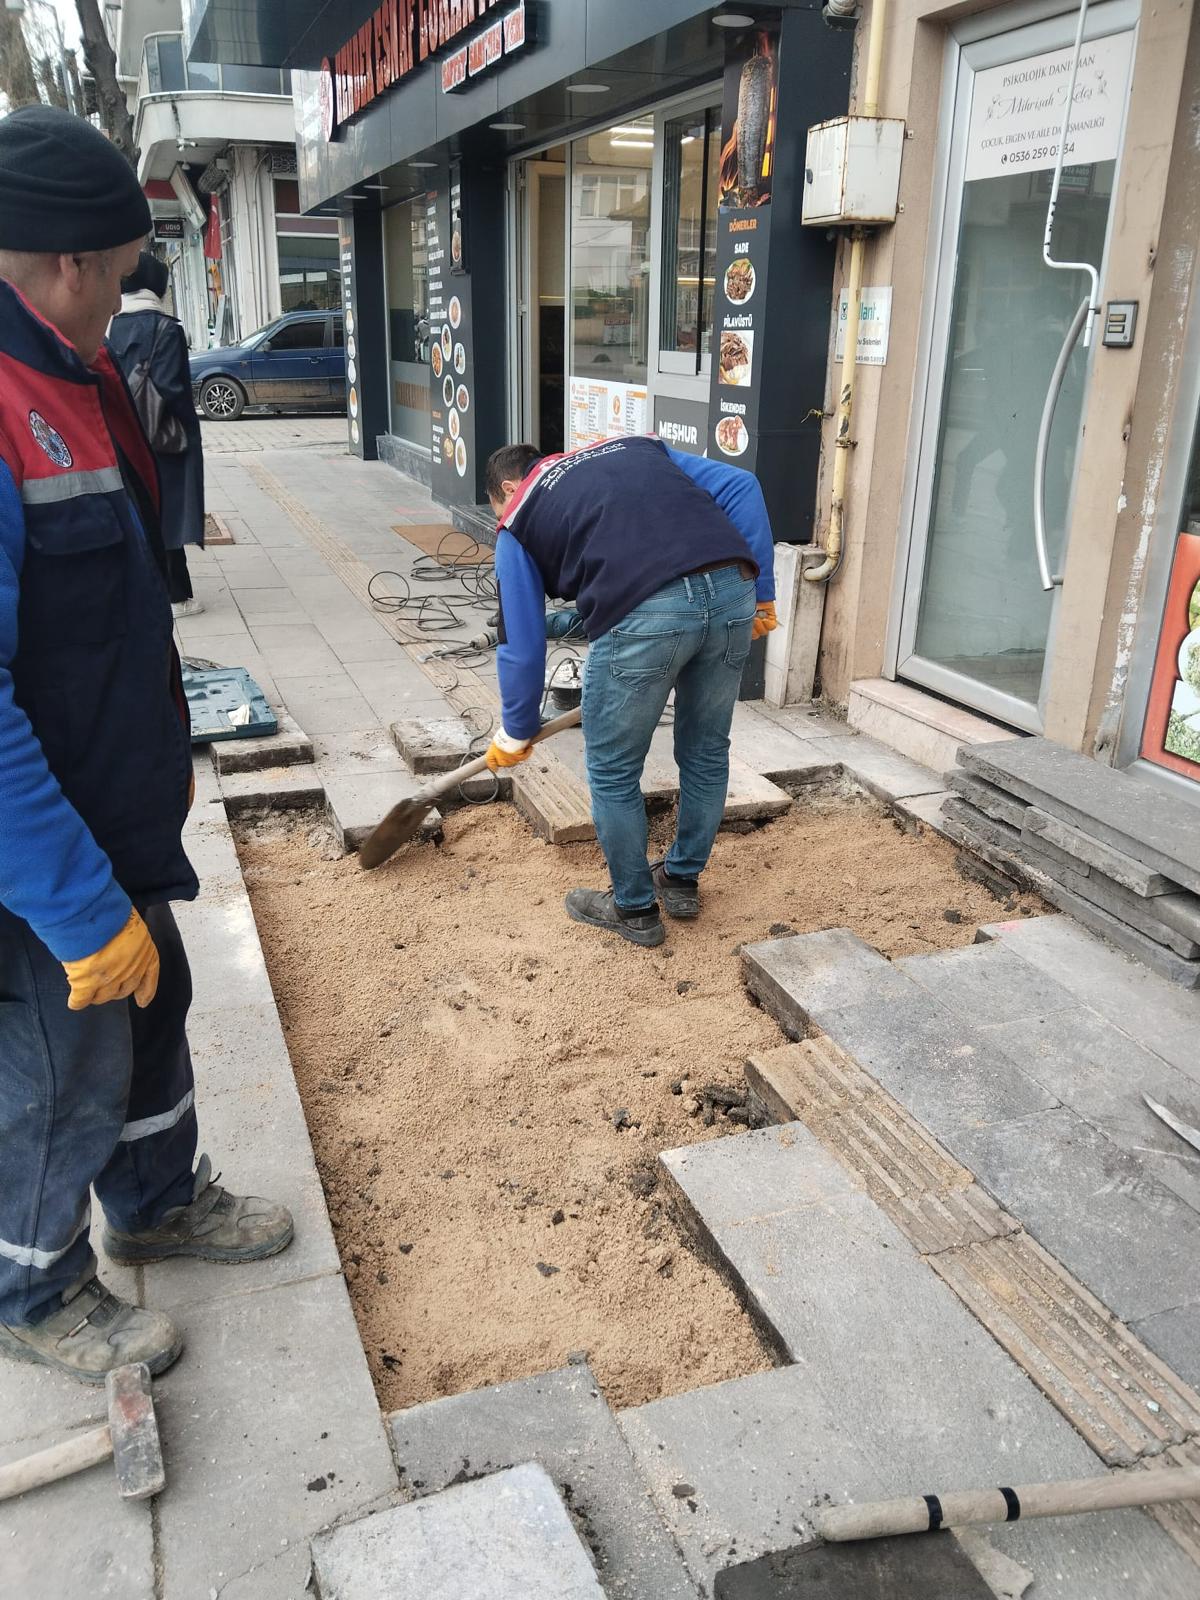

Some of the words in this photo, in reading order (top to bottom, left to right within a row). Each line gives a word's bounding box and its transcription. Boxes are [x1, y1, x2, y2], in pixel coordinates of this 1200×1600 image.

[1005, 132, 1027, 145] ERGEN
[1009, 149, 1031, 163] 0536
[1032, 146, 1048, 160] 259
[729, 219, 757, 233] DÖNERLER
[734, 242, 749, 254] SADE
[723, 314, 752, 328] PİLAVÜSTÜ
[720, 398, 746, 415] İSKENDER
[658, 420, 698, 445] MEŞHUR
